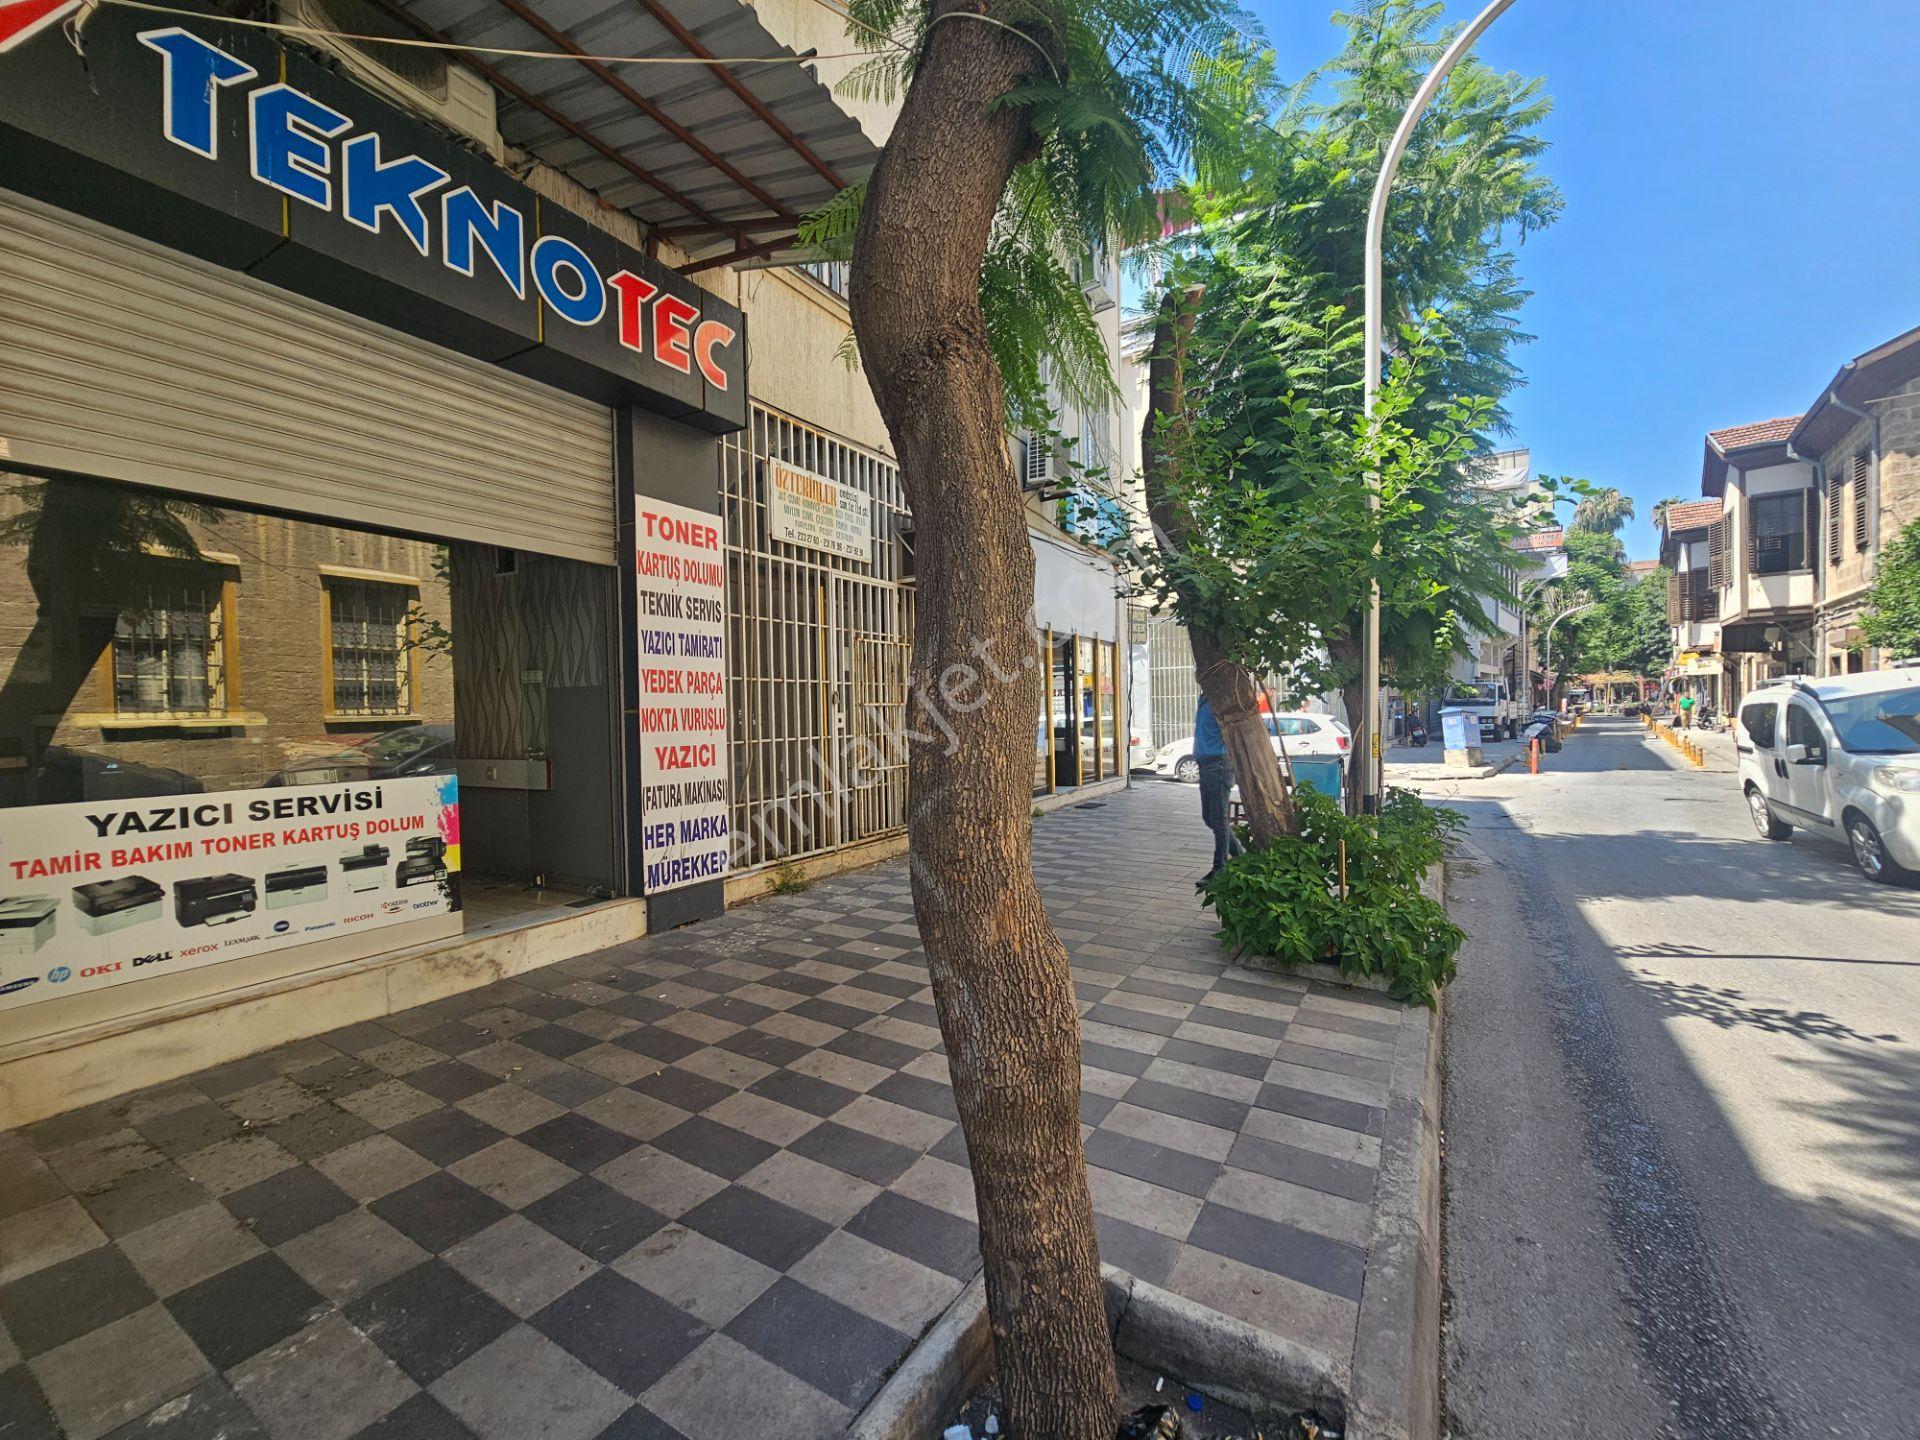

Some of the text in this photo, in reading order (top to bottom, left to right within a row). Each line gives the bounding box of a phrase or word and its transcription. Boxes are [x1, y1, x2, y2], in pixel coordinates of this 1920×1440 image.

[135, 26, 737, 391] TEKNOTEC
[642, 512, 718, 551] TONER
[638, 550, 723, 588] KARTUŞ DOLUMU
[641, 588, 722, 623] TEKNİK SERVİS
[641, 629, 722, 658] YAZICI TAMİRATI
[642, 669, 723, 700] YEDEK PARÇA
[642, 708, 726, 736] NOKTA VURUŞLU
[655, 744, 716, 770] YAZICI
[85, 786, 383, 838] YAZICI SERVİSİ
[642, 776, 728, 816] (FATURA MAKİNASI)
[10, 816, 424, 880] TAMİR BAKIM TONER KARTUŞ DOLUM
[644, 814, 728, 850] HER MARKA
[648, 850, 728, 888] MÜREKKEP
[80, 962, 123, 978] OKI
[132, 951, 173, 967] DELL
[180, 944, 218, 958] xerox
[344, 913, 374, 924] RICOH
[413, 900, 438, 910] brother
